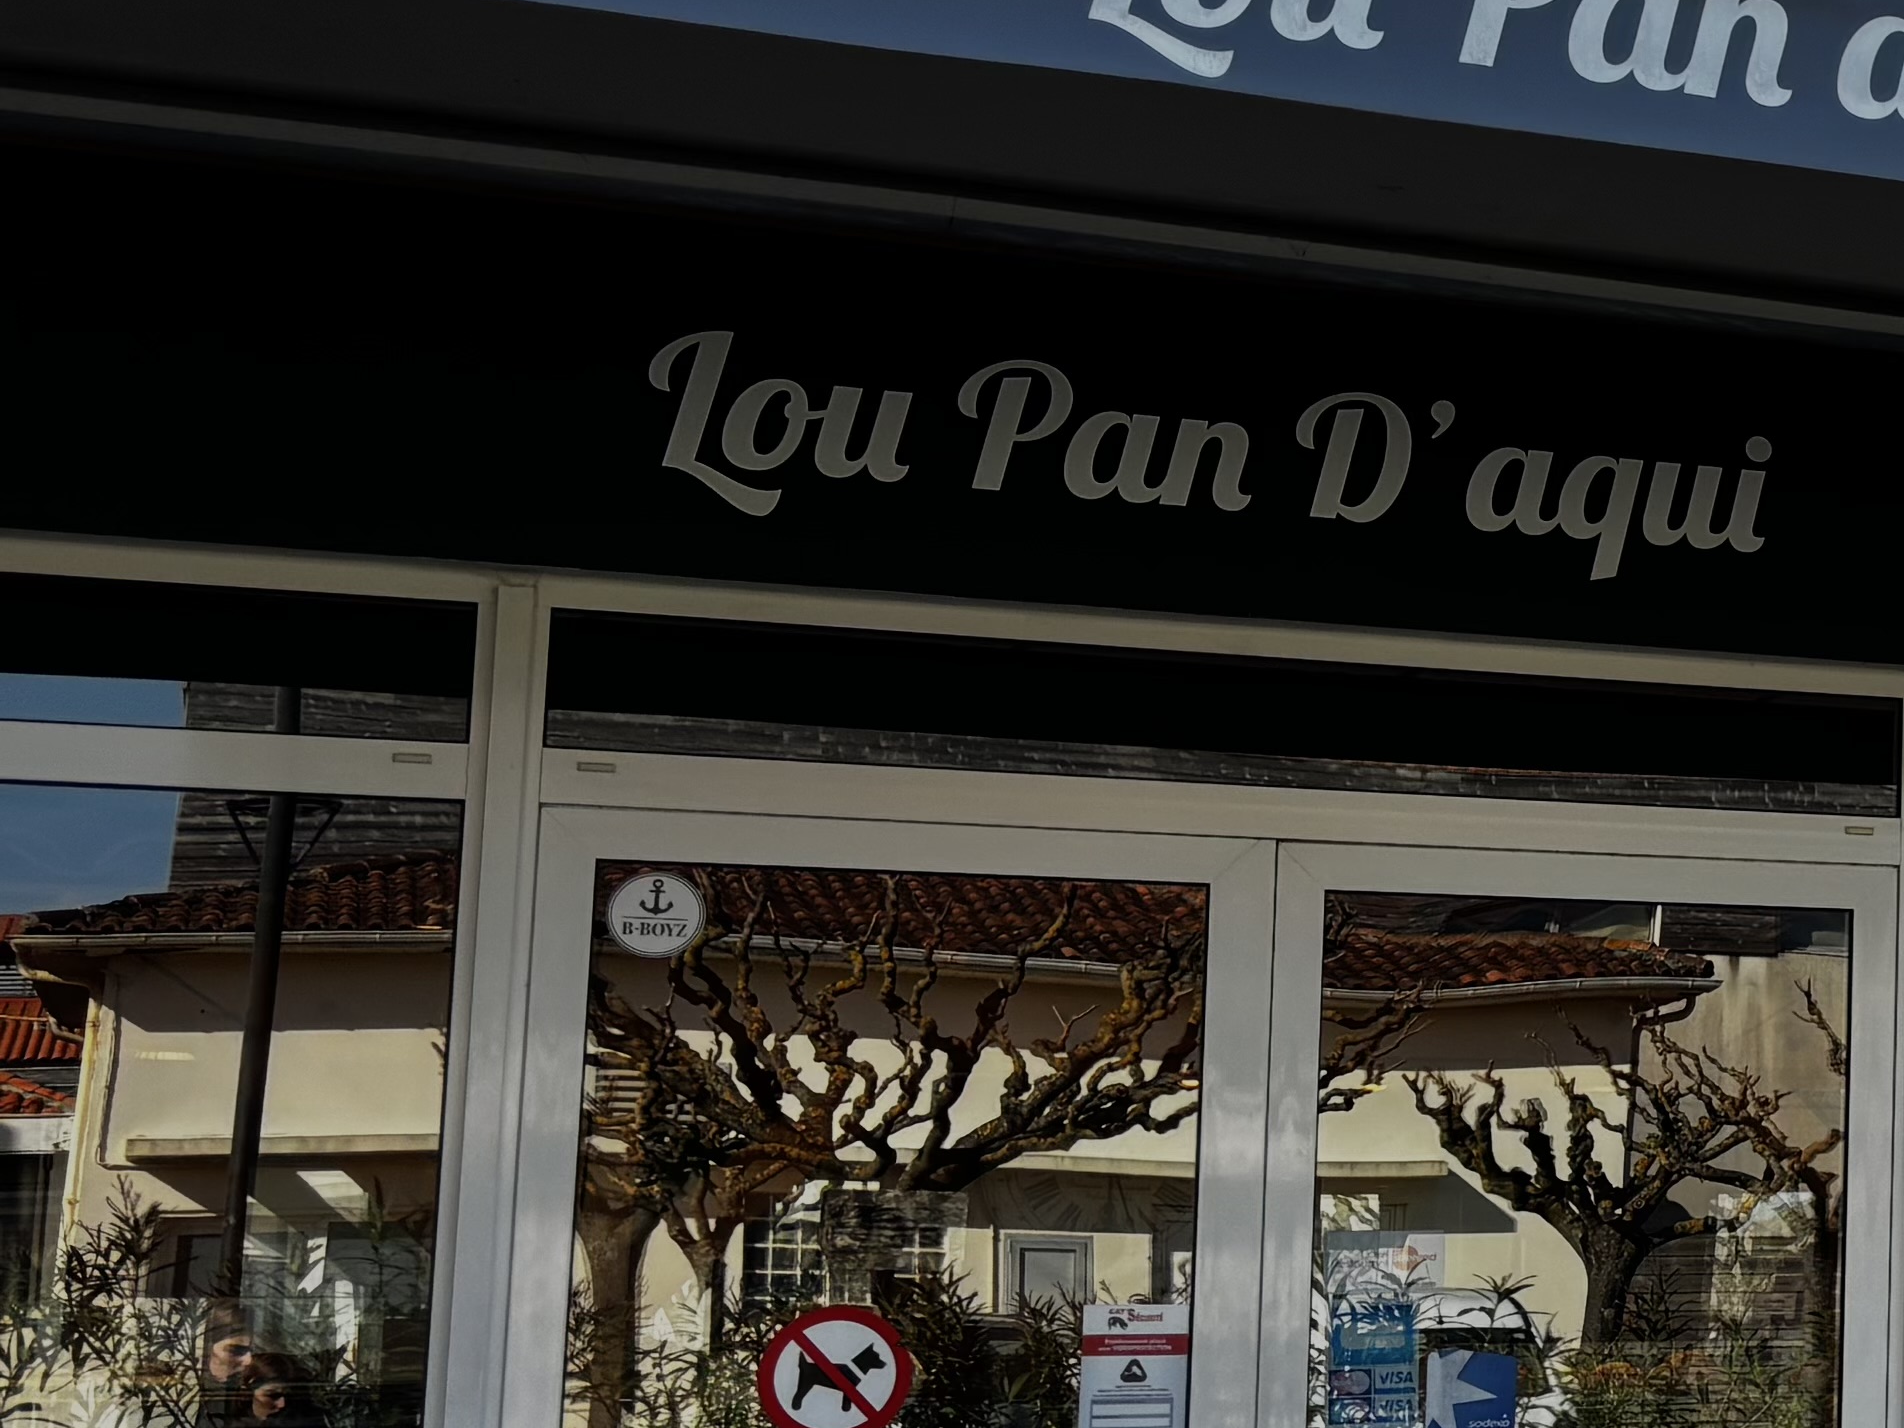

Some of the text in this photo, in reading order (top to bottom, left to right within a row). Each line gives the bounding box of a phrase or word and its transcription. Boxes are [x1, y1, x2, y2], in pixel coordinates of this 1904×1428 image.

[649, 331, 914, 516] Lou
[958, 360, 1252, 512] Pan
[622, 920, 688, 938] B-BOYZ
[1379, 1371, 1413, 1385] VISA
